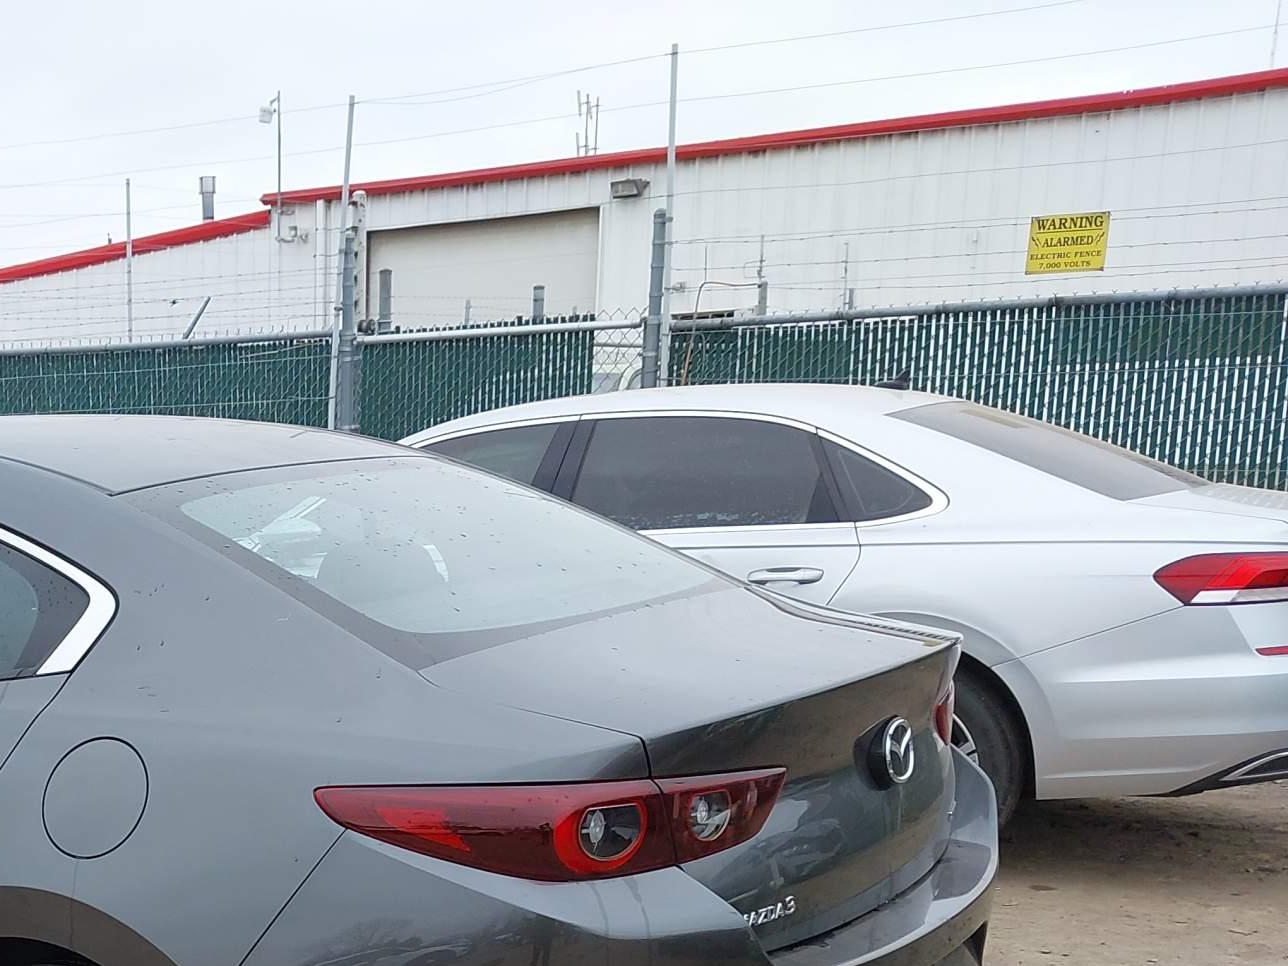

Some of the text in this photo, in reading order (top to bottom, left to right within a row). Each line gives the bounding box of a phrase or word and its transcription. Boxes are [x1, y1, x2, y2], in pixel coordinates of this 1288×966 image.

[1036, 215, 1104, 231] WARNING
[1042, 235, 1094, 248] ALARMED
[1030, 250, 1102, 261] ELECTRIC FENCE
[1064, 260, 1091, 268] VOLTS
[743, 895, 797, 927] AZDA3
